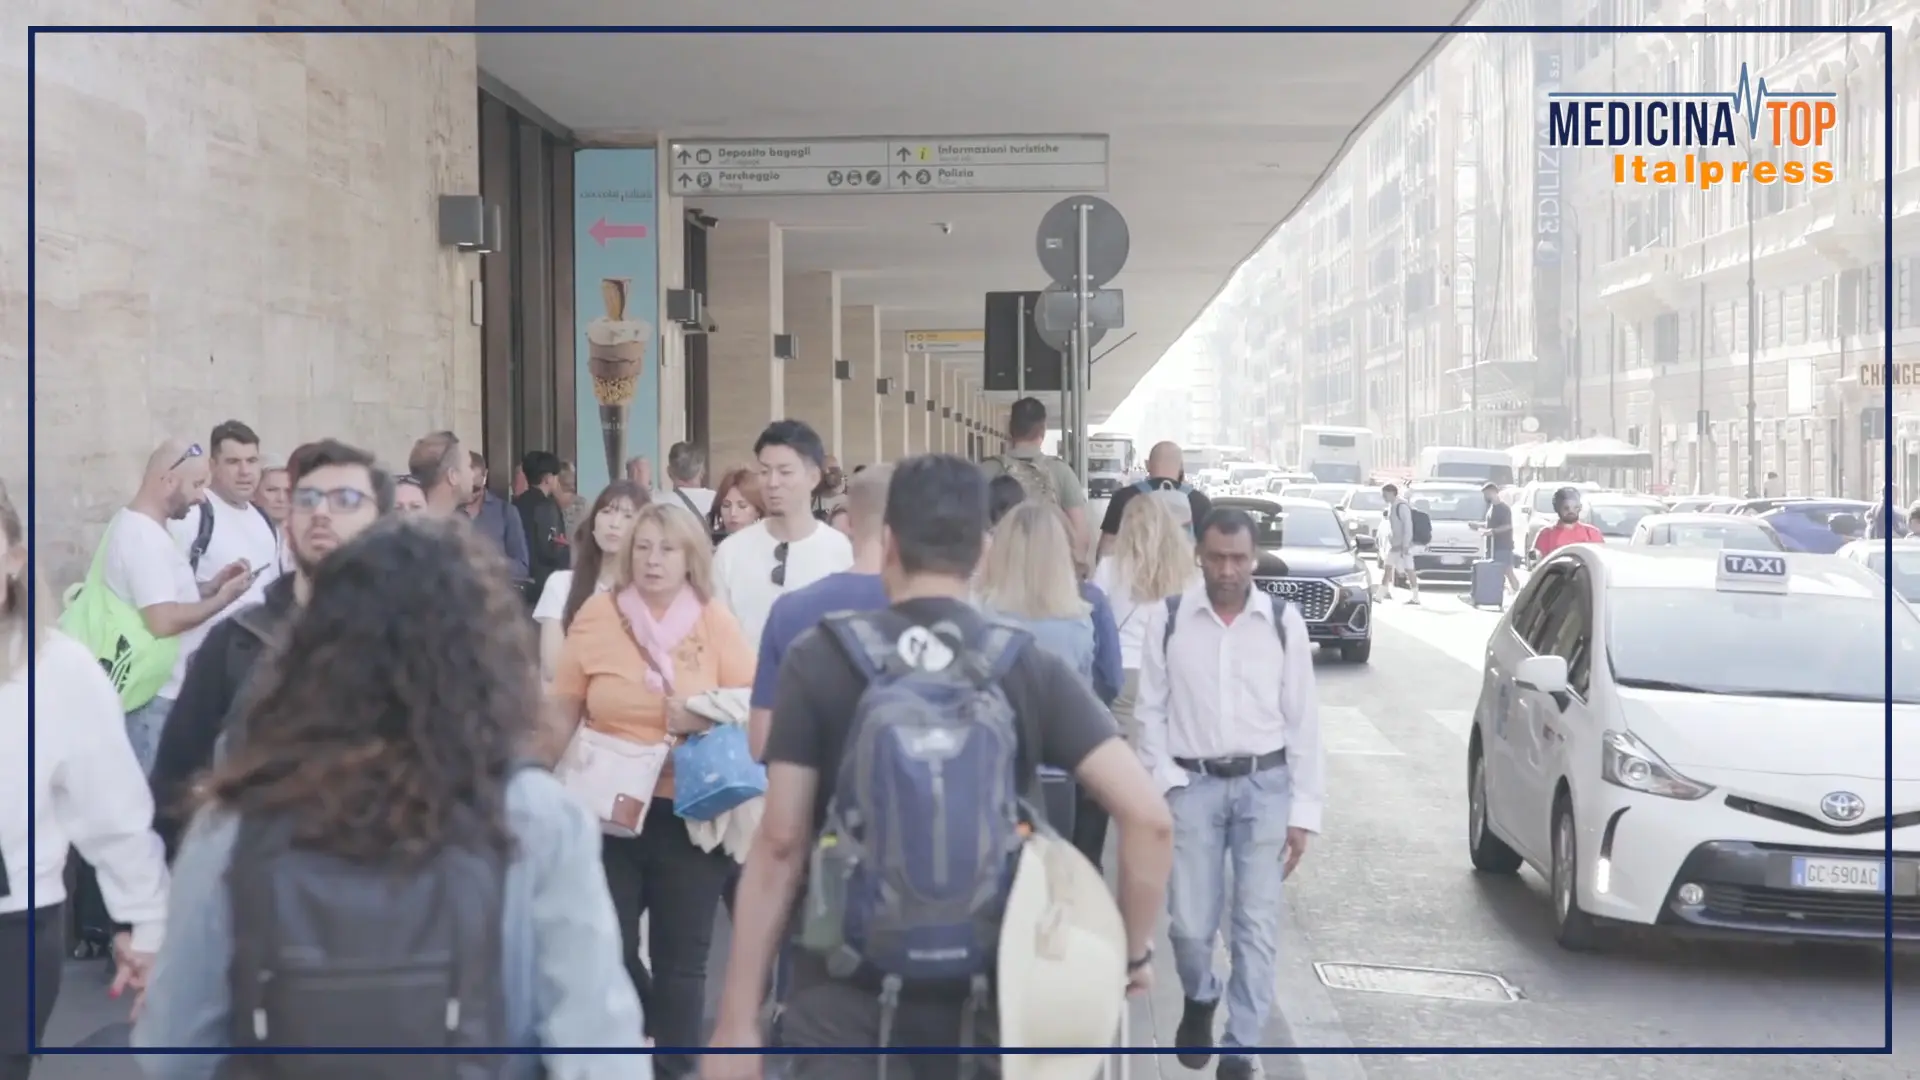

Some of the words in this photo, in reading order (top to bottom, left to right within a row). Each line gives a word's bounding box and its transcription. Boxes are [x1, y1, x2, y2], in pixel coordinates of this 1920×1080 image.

[718, 148, 766, 159] Deposito
[769, 146, 811, 159] bagagli
[937, 145, 1007, 155] Informazioni
[1010, 144, 1059, 154] turistiche
[719, 171, 780, 183] Parcheggio
[938, 168, 974, 178] Polizia
[1726, 556, 1783, 574] TAXI
